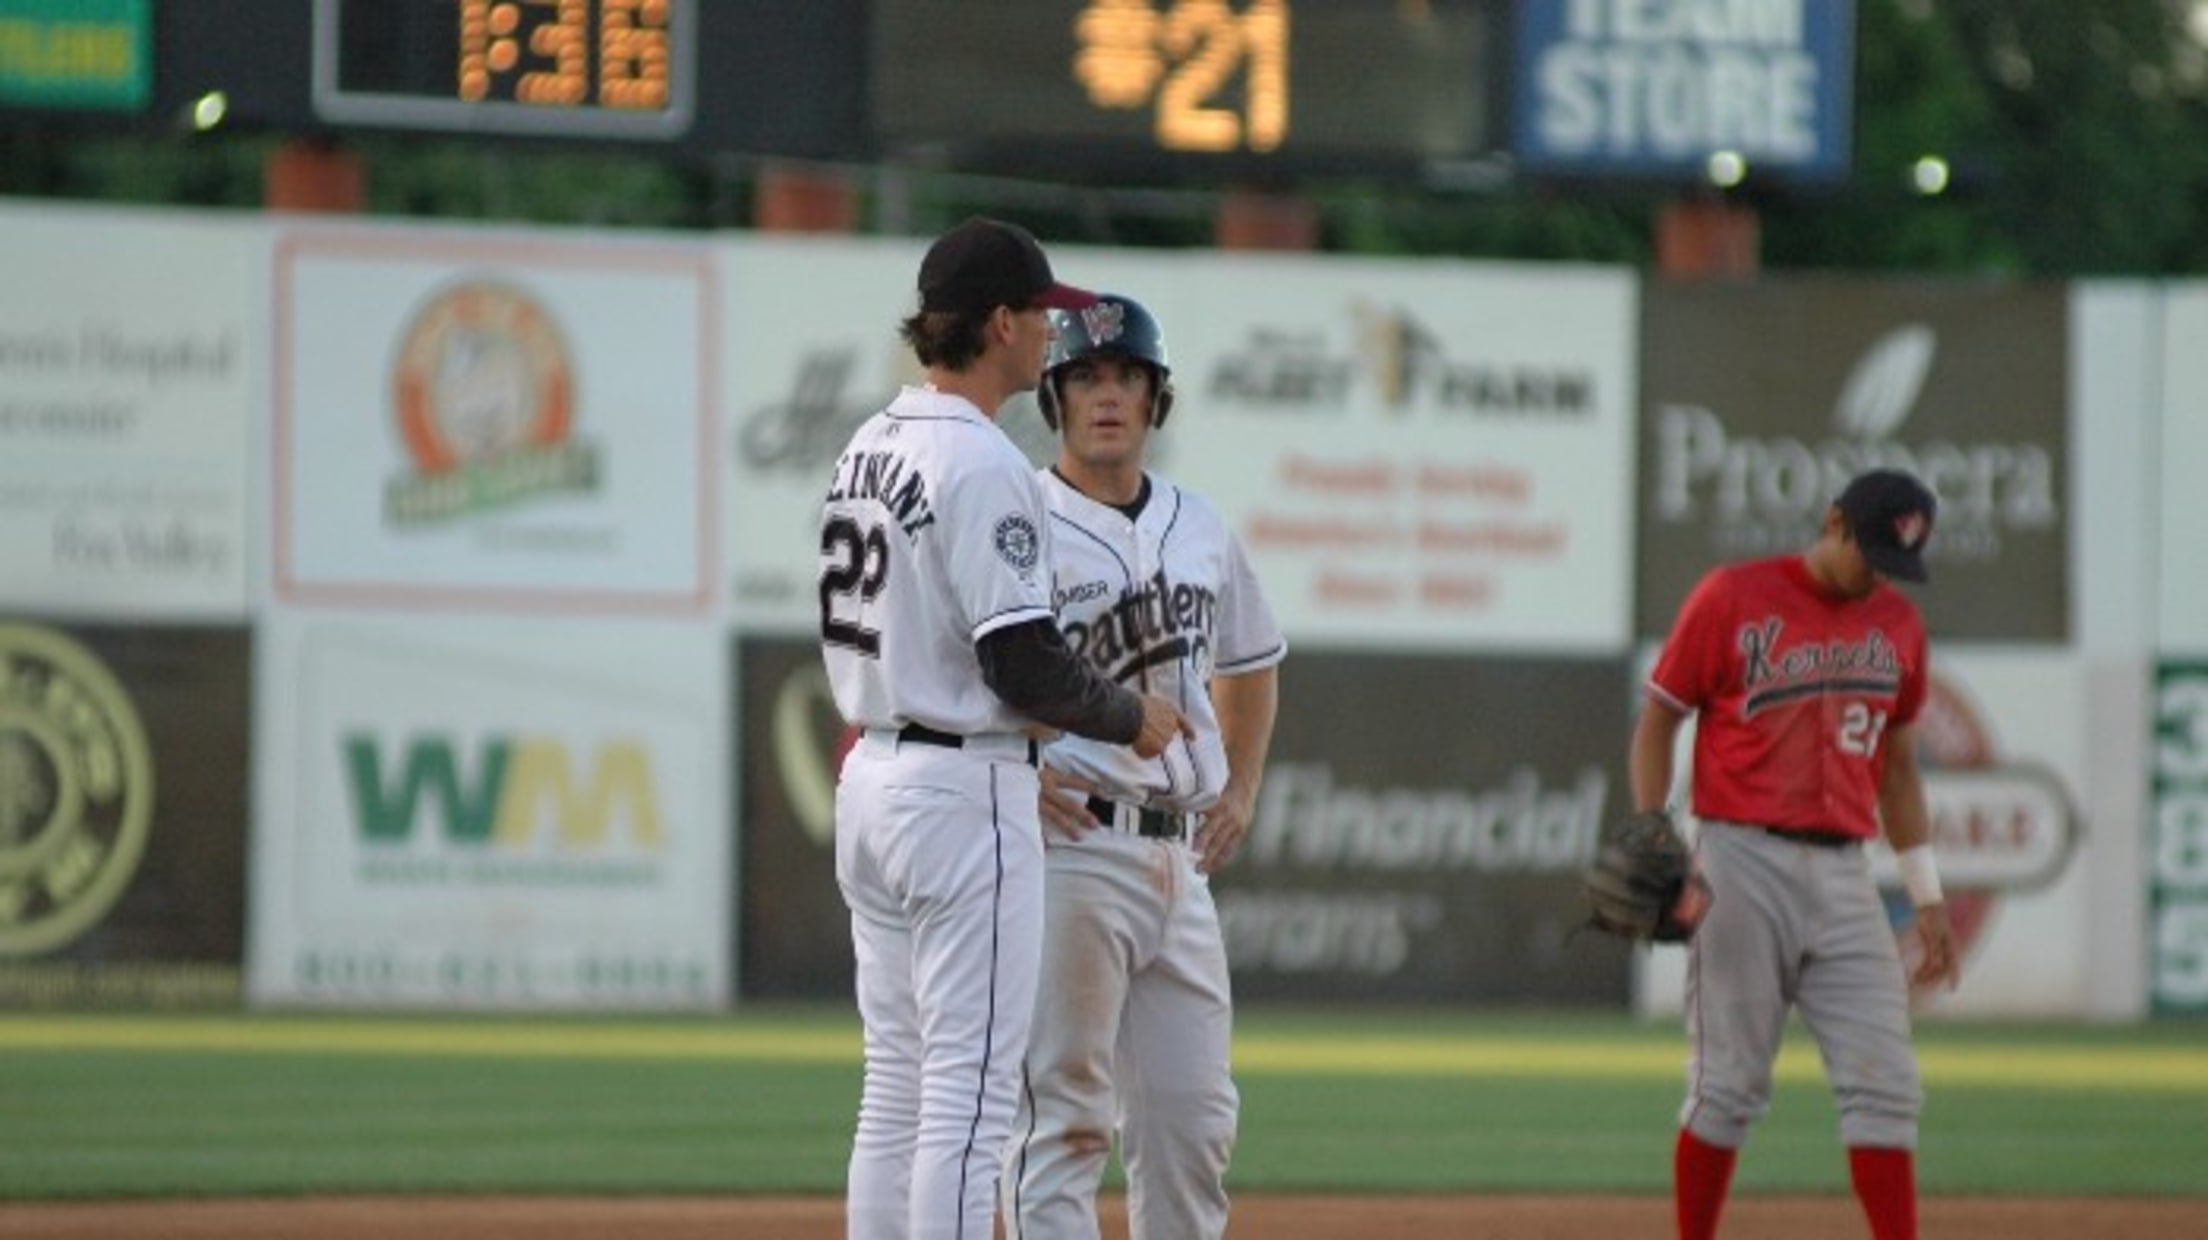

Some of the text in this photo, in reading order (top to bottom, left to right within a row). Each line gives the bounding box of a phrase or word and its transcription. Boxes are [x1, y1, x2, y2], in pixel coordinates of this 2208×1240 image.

[1540, 44, 1819, 161] STORE
[1738, 616, 1902, 688] Kernels
[341, 731, 666, 848] WM
[1255, 764, 1608, 872] Financial
